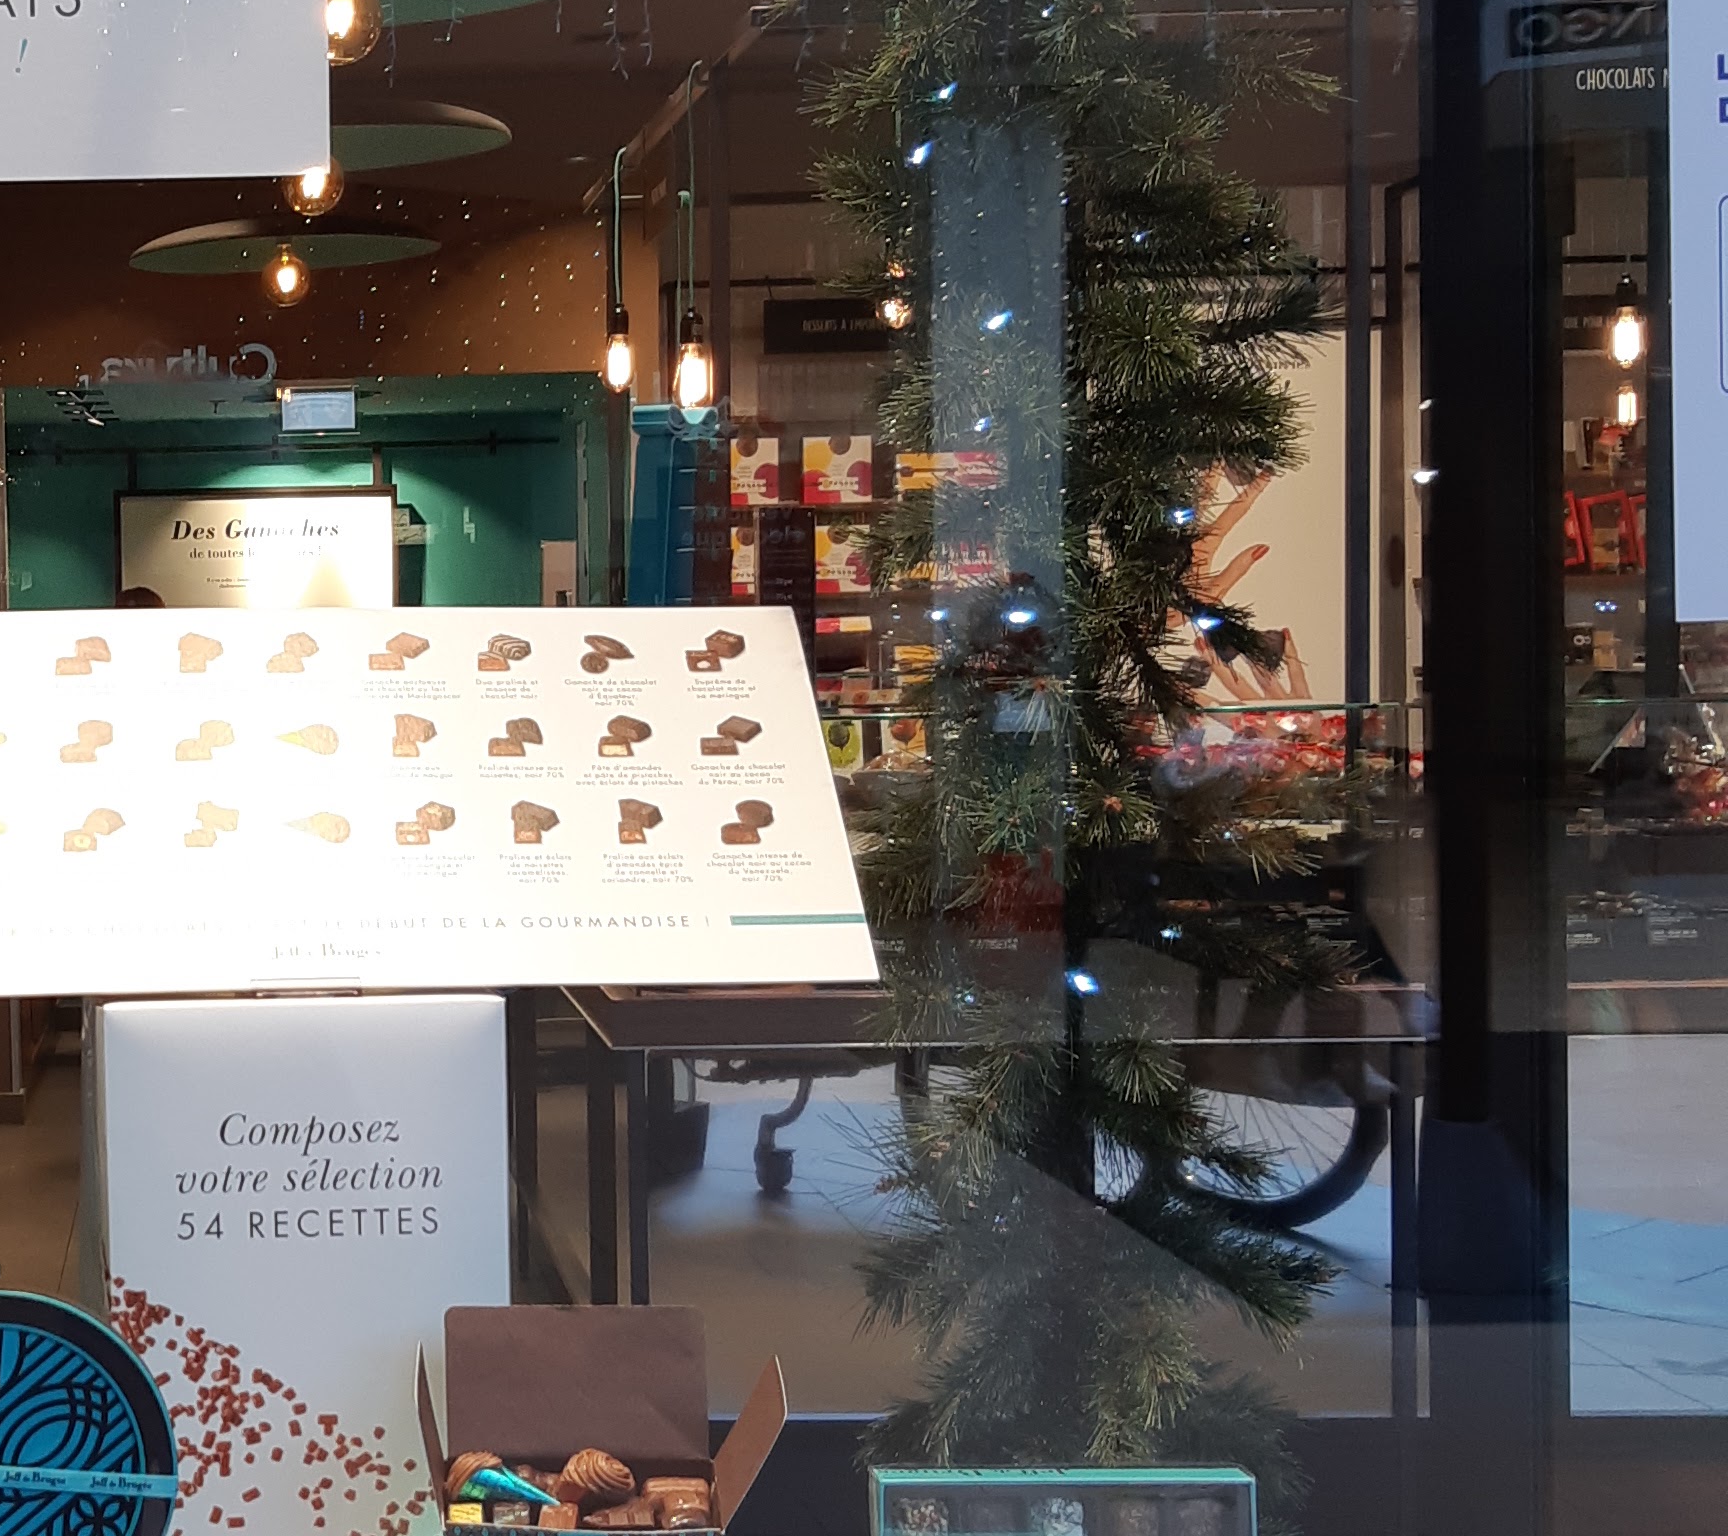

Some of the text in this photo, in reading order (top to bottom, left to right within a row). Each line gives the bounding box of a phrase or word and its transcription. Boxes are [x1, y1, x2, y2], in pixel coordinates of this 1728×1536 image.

[1576, 67, 1656, 91] CHOCOLATS
[171, 519, 216, 540] Des
[207, 548, 244, 559] toutes
[443, 917, 468, 929] DE
[482, 916, 507, 928] LA
[521, 915, 690, 928] GOURMANDISE
[219, 1112, 401, 1156] Composez
[175, 1157, 444, 1195] votre sélection
[176, 1206, 440, 1241] 54 RECETTES
